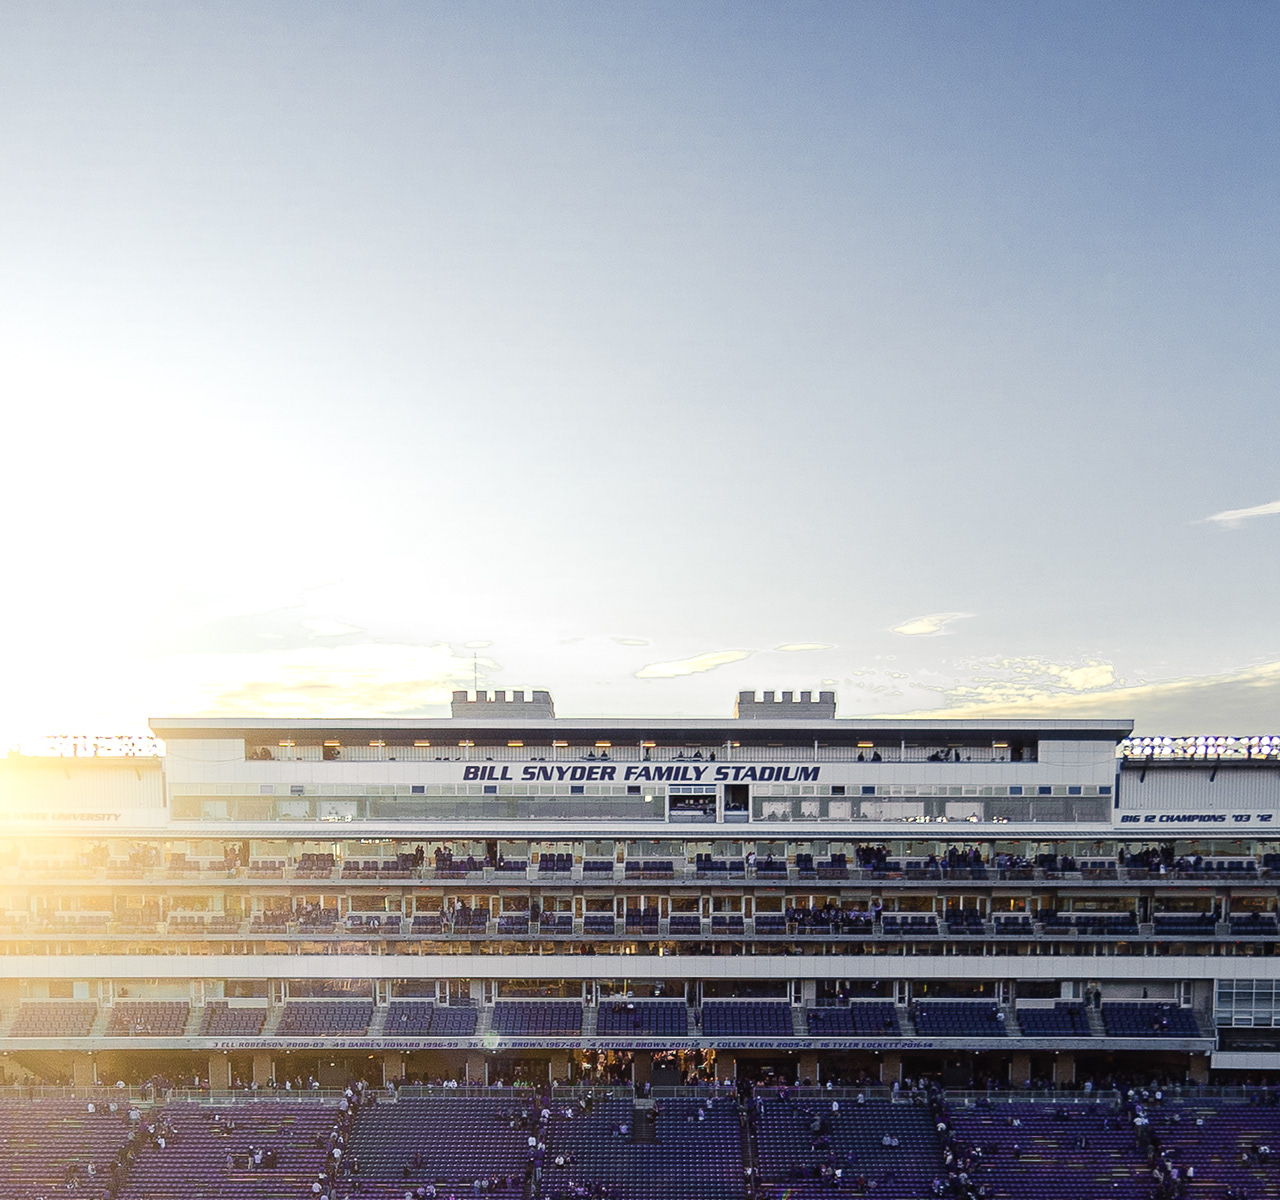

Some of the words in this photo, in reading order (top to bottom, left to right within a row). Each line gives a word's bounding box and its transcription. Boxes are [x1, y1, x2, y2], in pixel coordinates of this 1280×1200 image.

[463, 766, 514, 781] BILL
[521, 766, 617, 781] SNYDER
[624, 766, 710, 781] FAMILY
[714, 766, 821, 781] STADIUM
[51, 813, 122, 821] UNIVERSITY
[1121, 815, 1141, 823] BIG
[1256, 814, 1273, 822] '12
